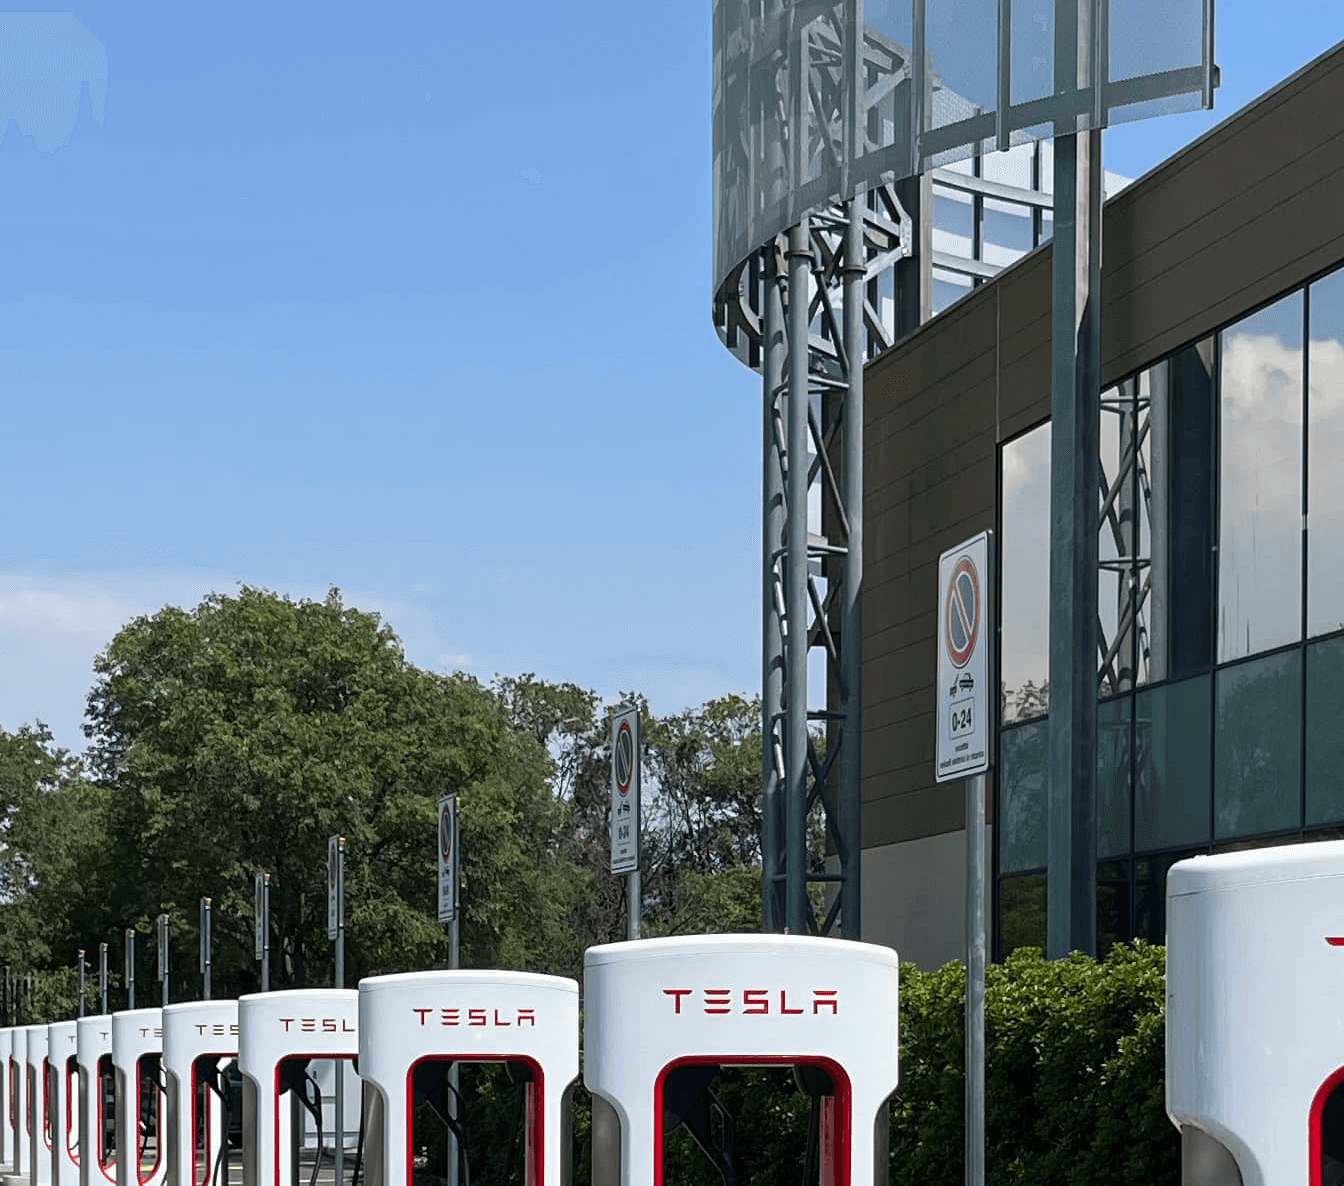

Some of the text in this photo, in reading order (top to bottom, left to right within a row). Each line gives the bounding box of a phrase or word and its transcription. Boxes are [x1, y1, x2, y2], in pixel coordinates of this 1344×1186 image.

[951, 707, 972, 732] 0-24
[662, 989, 839, 1015] TESLA
[412, 1008, 536, 1027] TESLA
